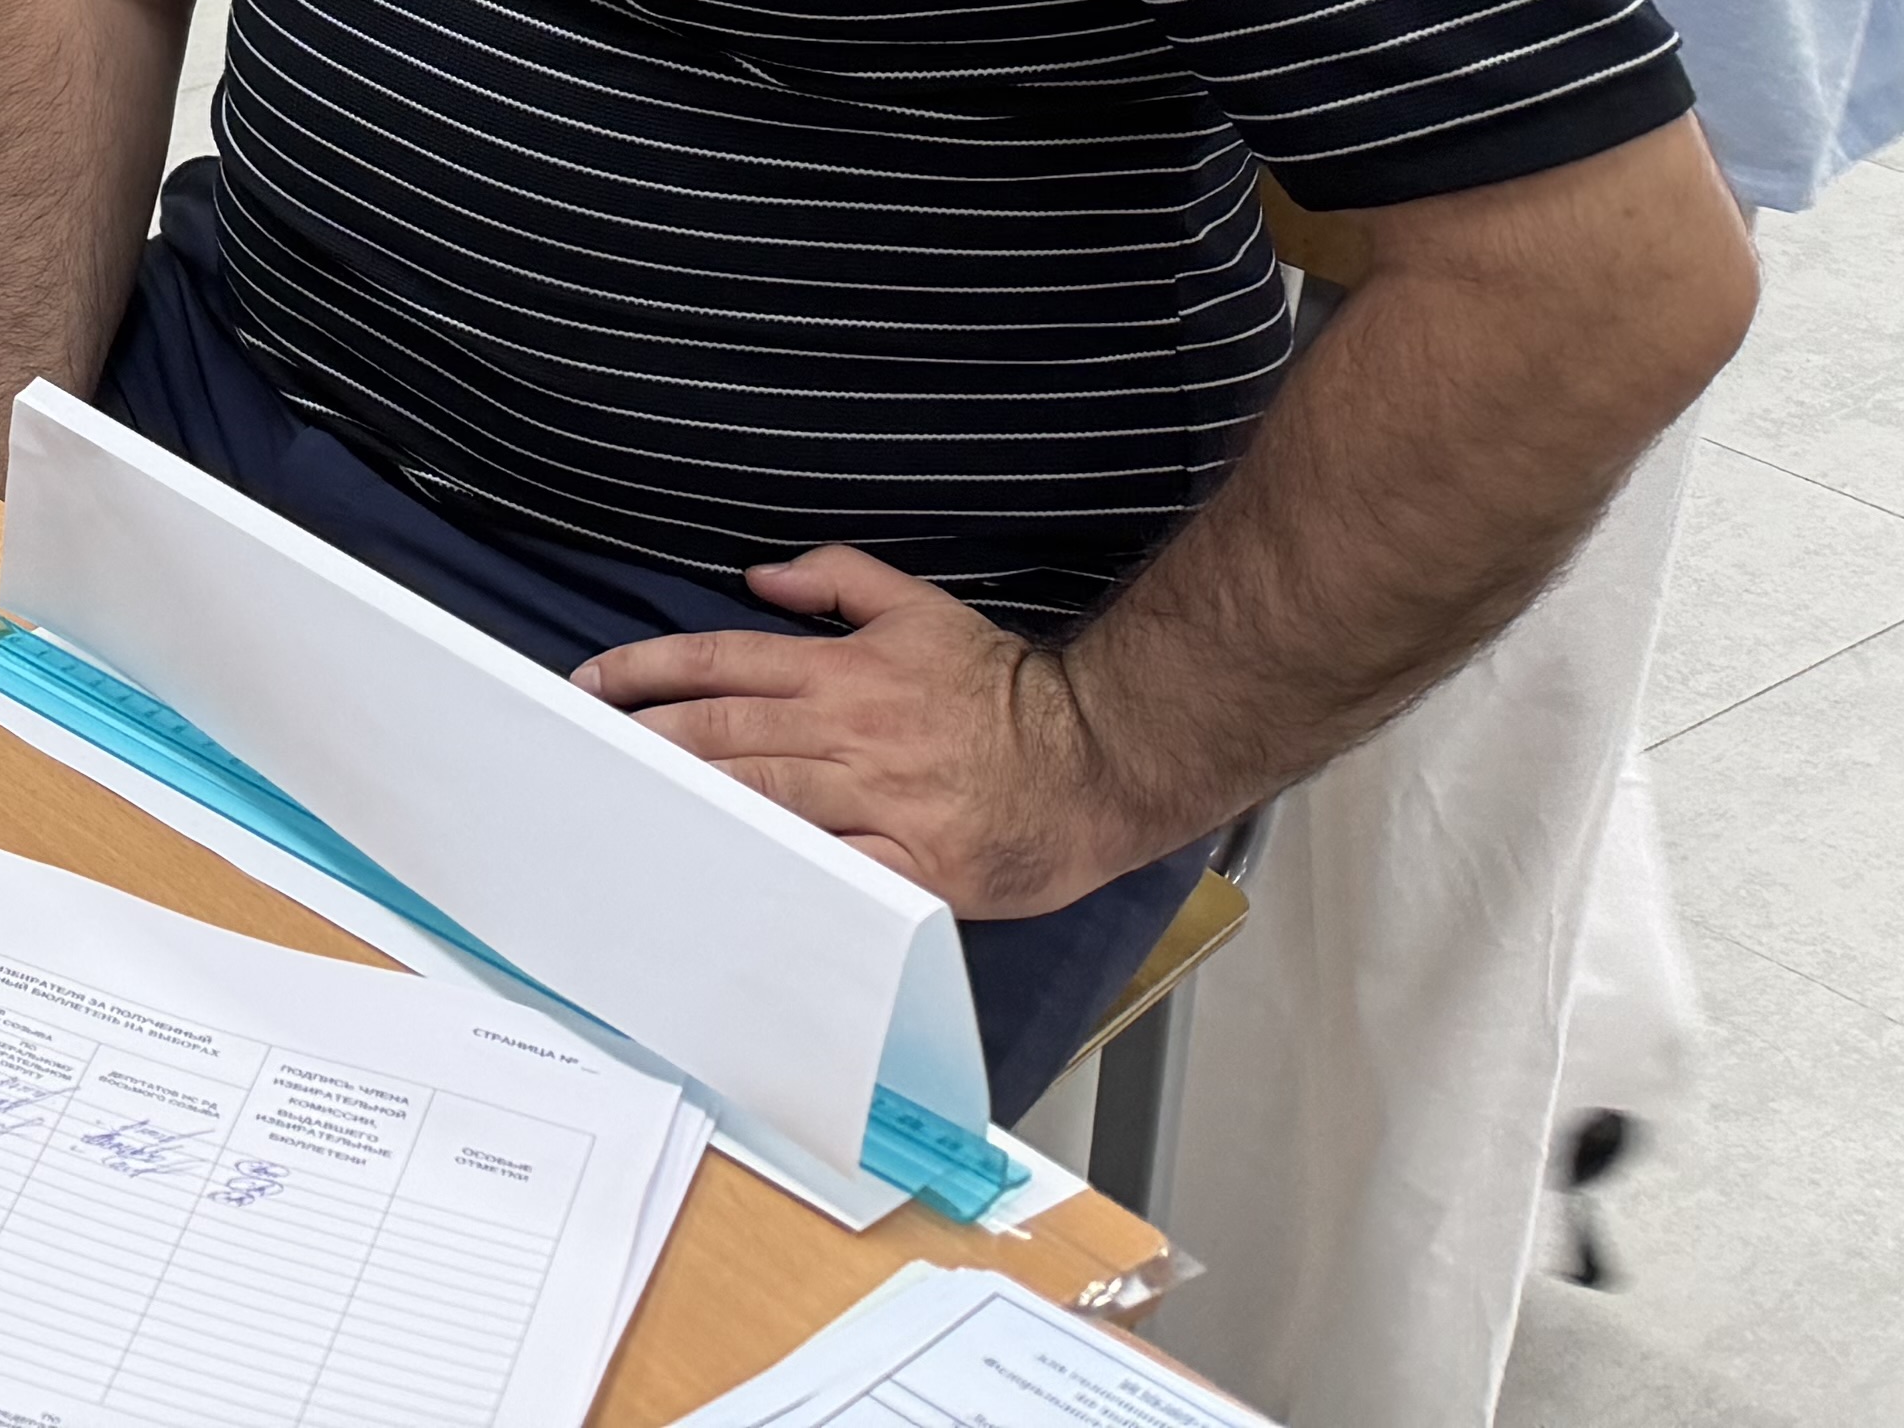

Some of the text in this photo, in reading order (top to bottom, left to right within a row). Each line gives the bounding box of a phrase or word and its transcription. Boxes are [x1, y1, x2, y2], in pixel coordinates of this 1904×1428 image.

[30, 987, 122, 1029] БЮЛЛЕТЕНЬ
[122, 1020, 143, 1036] НА
[144, 1027, 221, 1059] ВЫБОРАХ
[87, 995, 107, 1011] ЗА
[109, 1003, 214, 1045] ПОЛУЧЕННЫЙ
[472, 1027, 556, 1061] СТРАНИЦА
[272, 1077, 408, 1122] ИЗБИРАТЕЛЬНОЙ
[280, 1064, 410, 1107] ПОДПИСЬ ЧЛЕНА
[461, 1146, 533, 1175] ОСОБЫЕ
